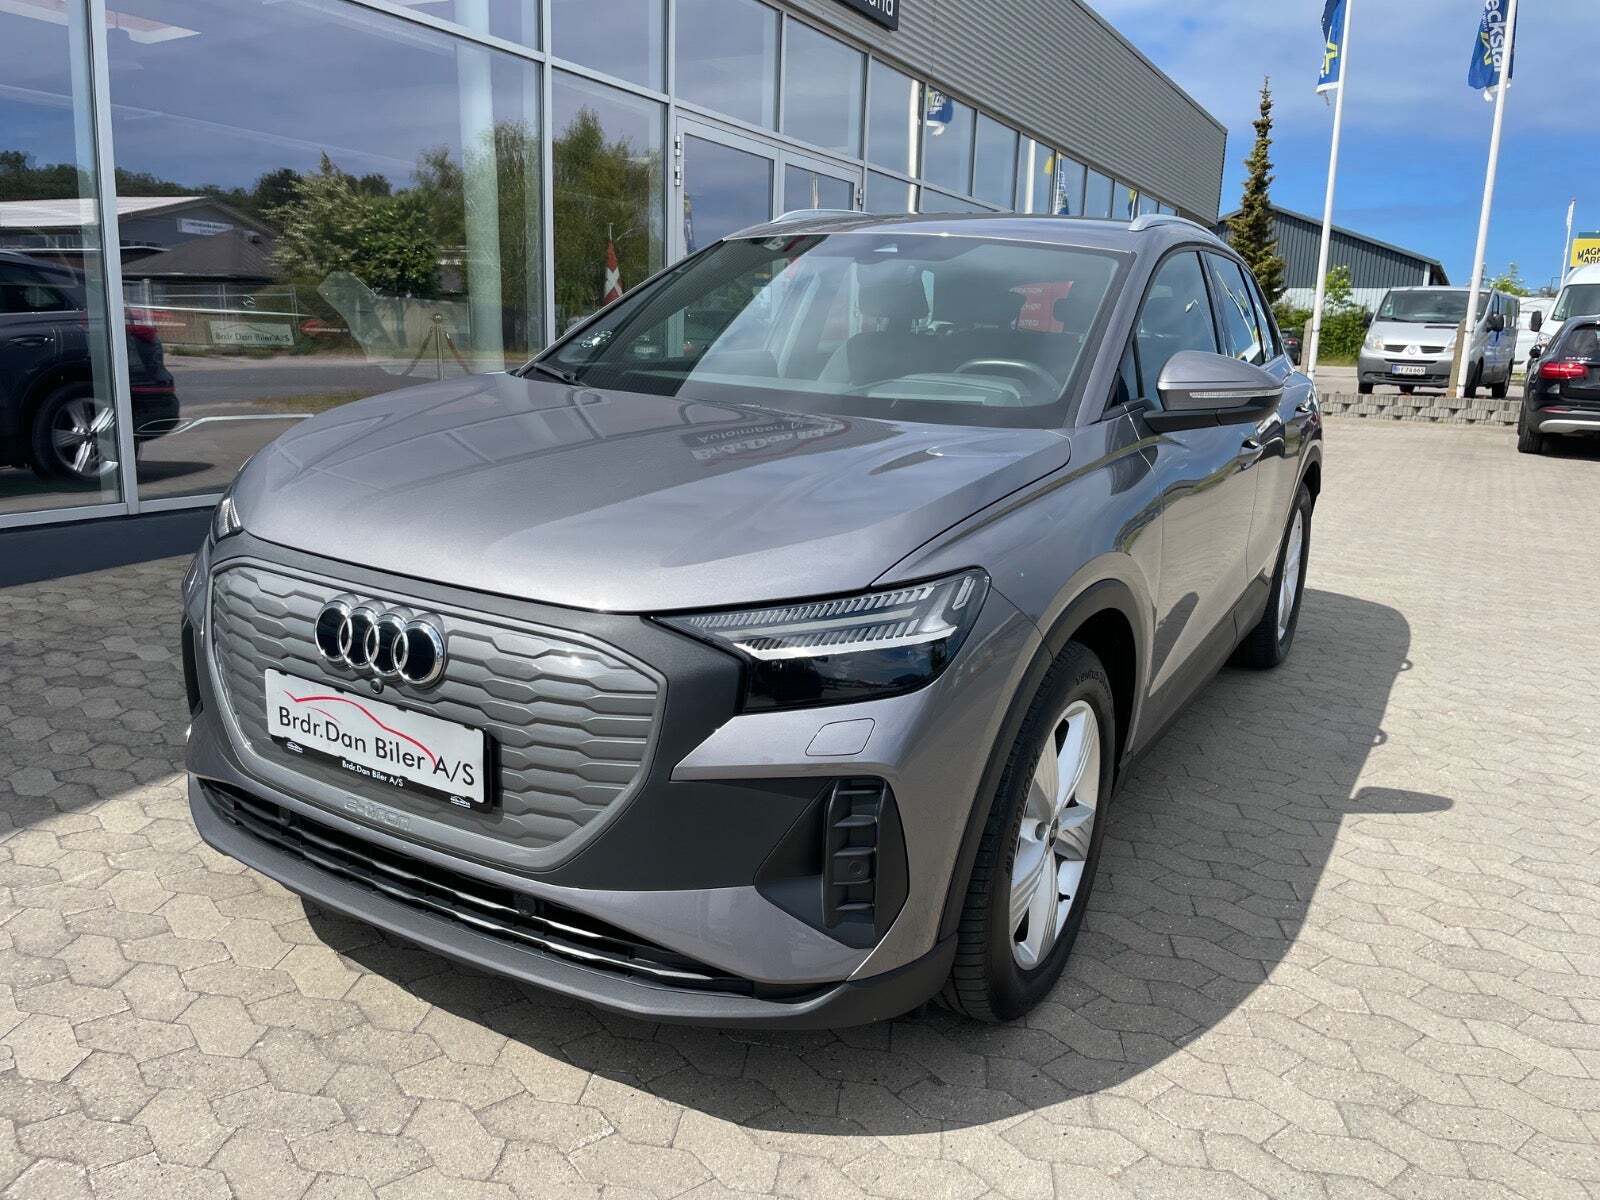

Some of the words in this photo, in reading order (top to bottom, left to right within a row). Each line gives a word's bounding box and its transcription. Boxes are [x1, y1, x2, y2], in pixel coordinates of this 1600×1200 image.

[279, 706, 367, 753] Brdr.Dan
[375, 736, 426, 769] Biler
[432, 755, 475, 786] A/S
[372, 770, 387, 781] Biler
[389, 776, 403, 787] A/S
